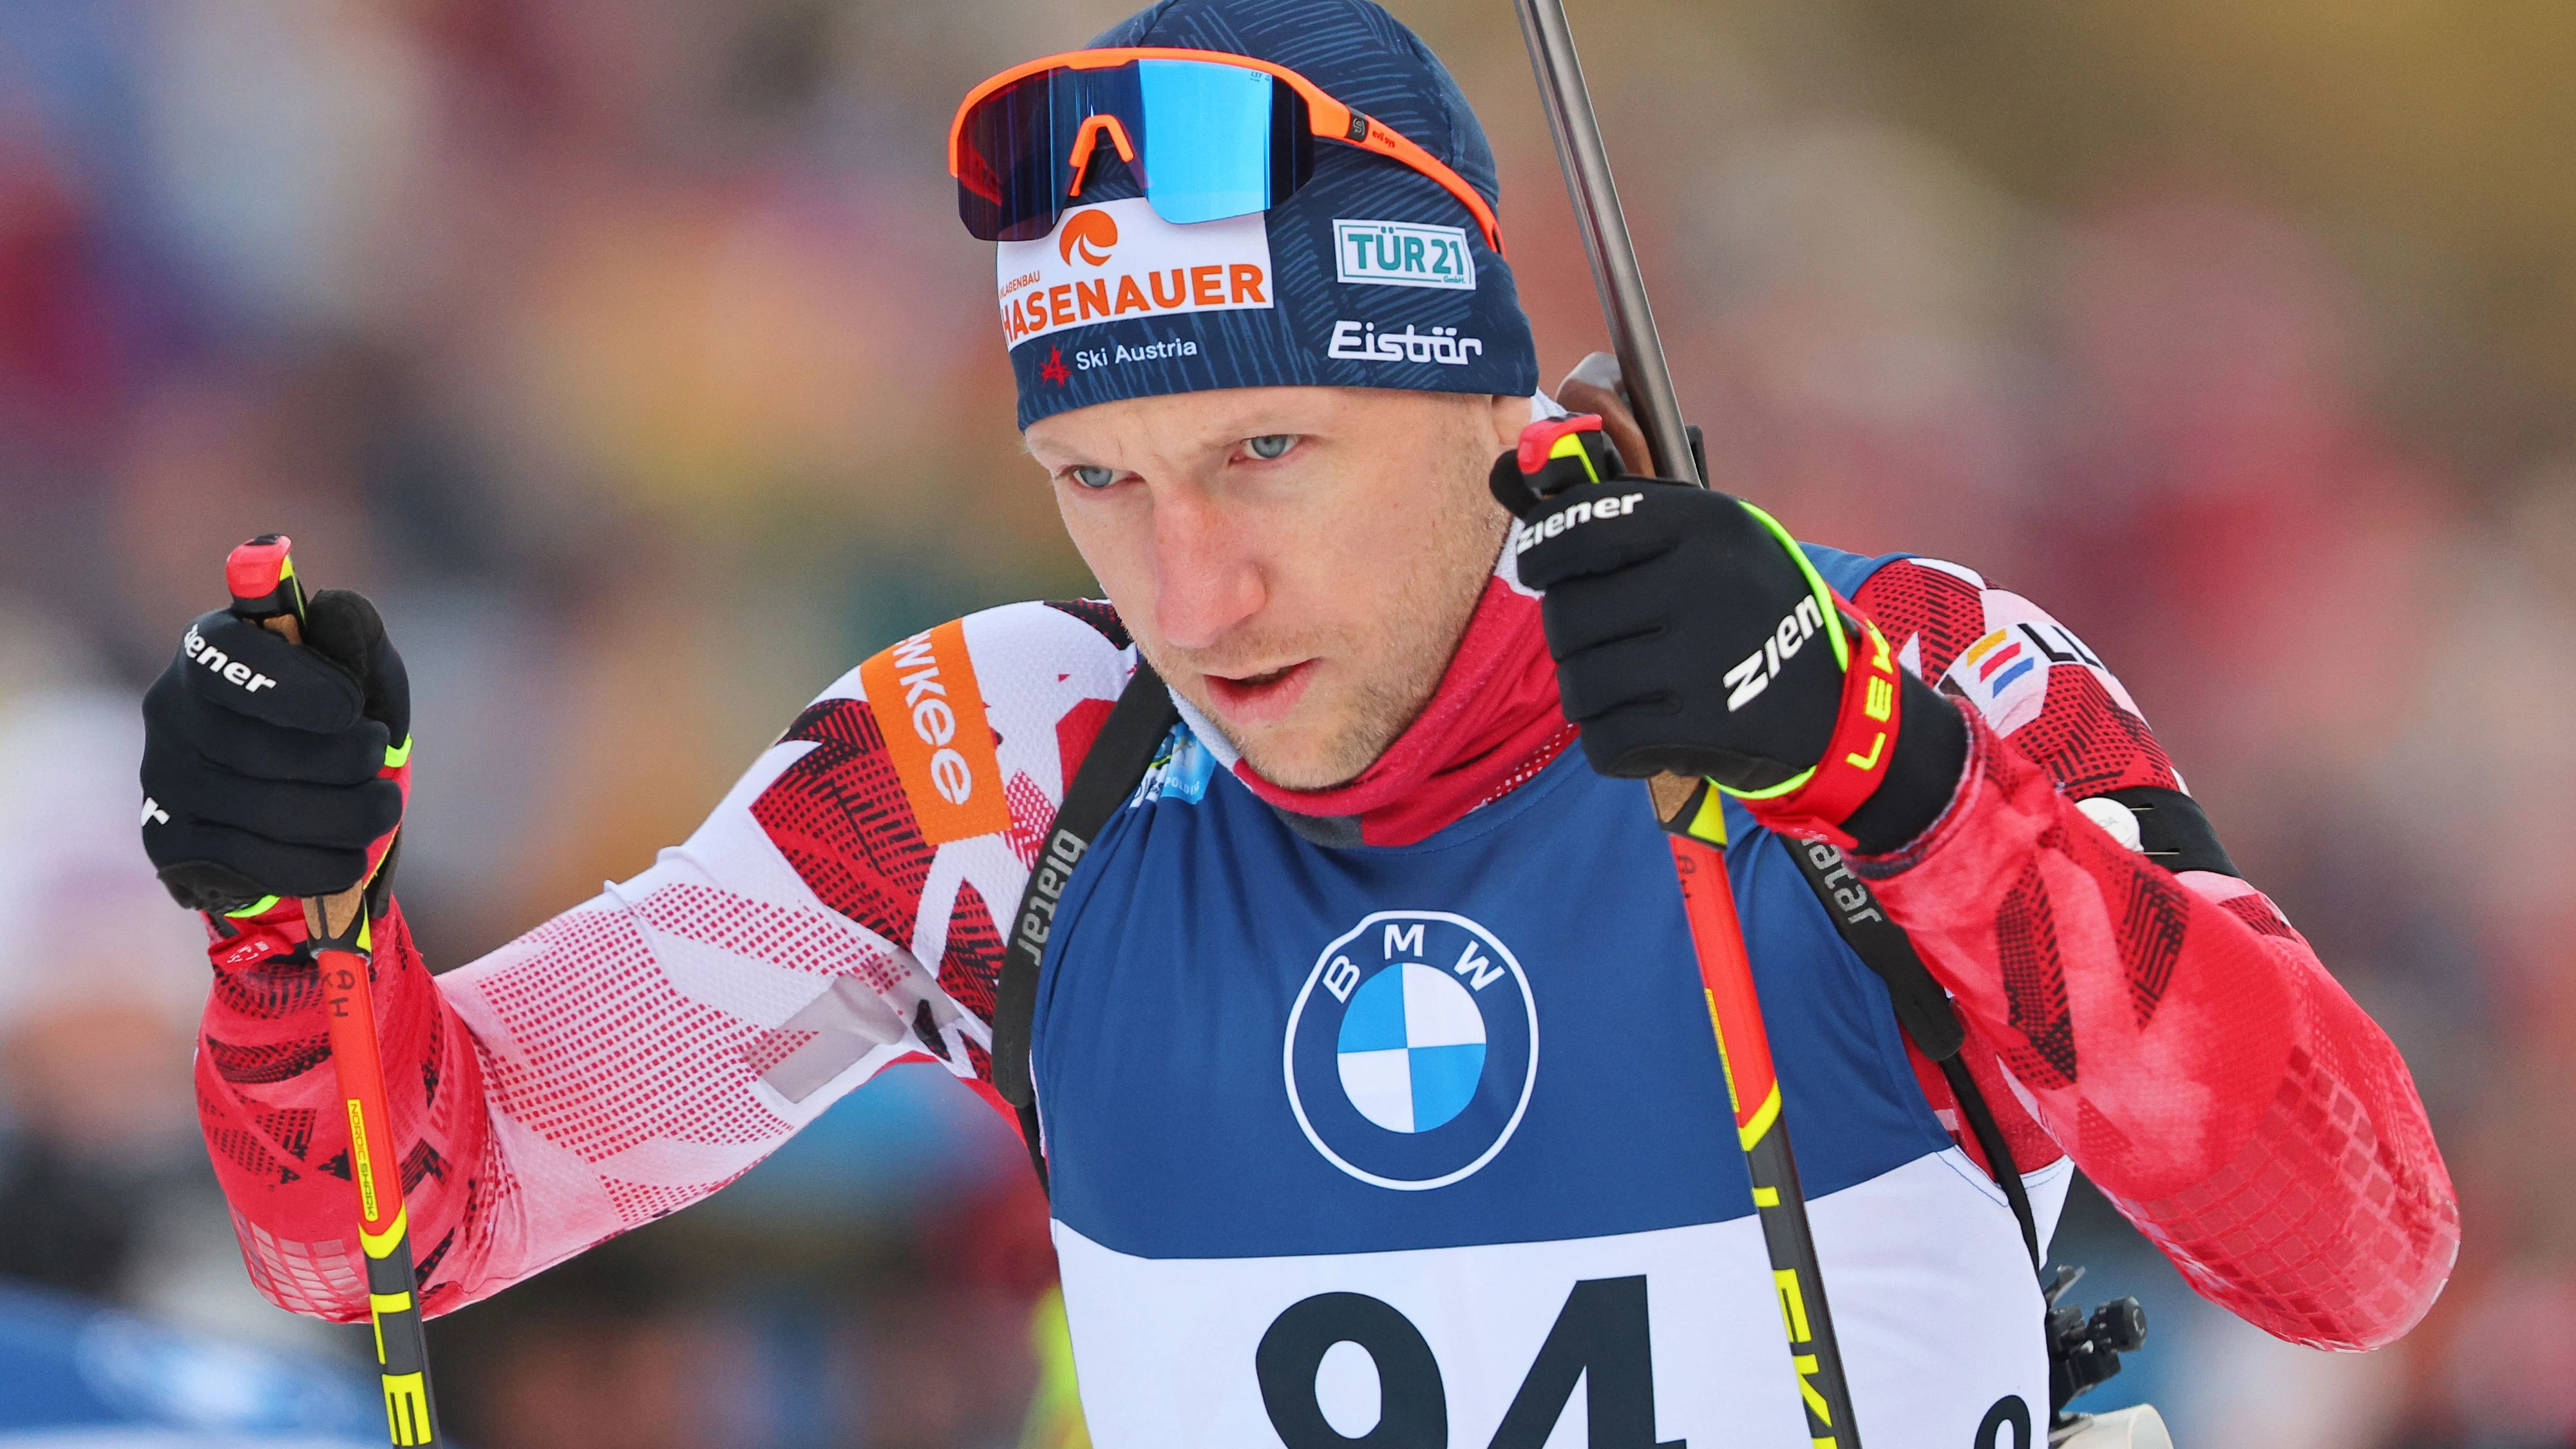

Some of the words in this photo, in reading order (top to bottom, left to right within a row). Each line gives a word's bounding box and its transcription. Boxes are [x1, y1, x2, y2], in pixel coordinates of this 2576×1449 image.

[1348, 226, 1426, 272] TÜR
[1431, 239, 1464, 274] 21
[1076, 348, 1108, 370] Ski
[1115, 338, 1197, 364] Austria
[1328, 320, 1482, 365] Eisbär
[1323, 923, 1505, 1003] BMW
[350, 1104, 366, 1160] NORDIC
[360, 1163, 375, 1217] SHARK
[1256, 1274, 1687, 1449] 94
